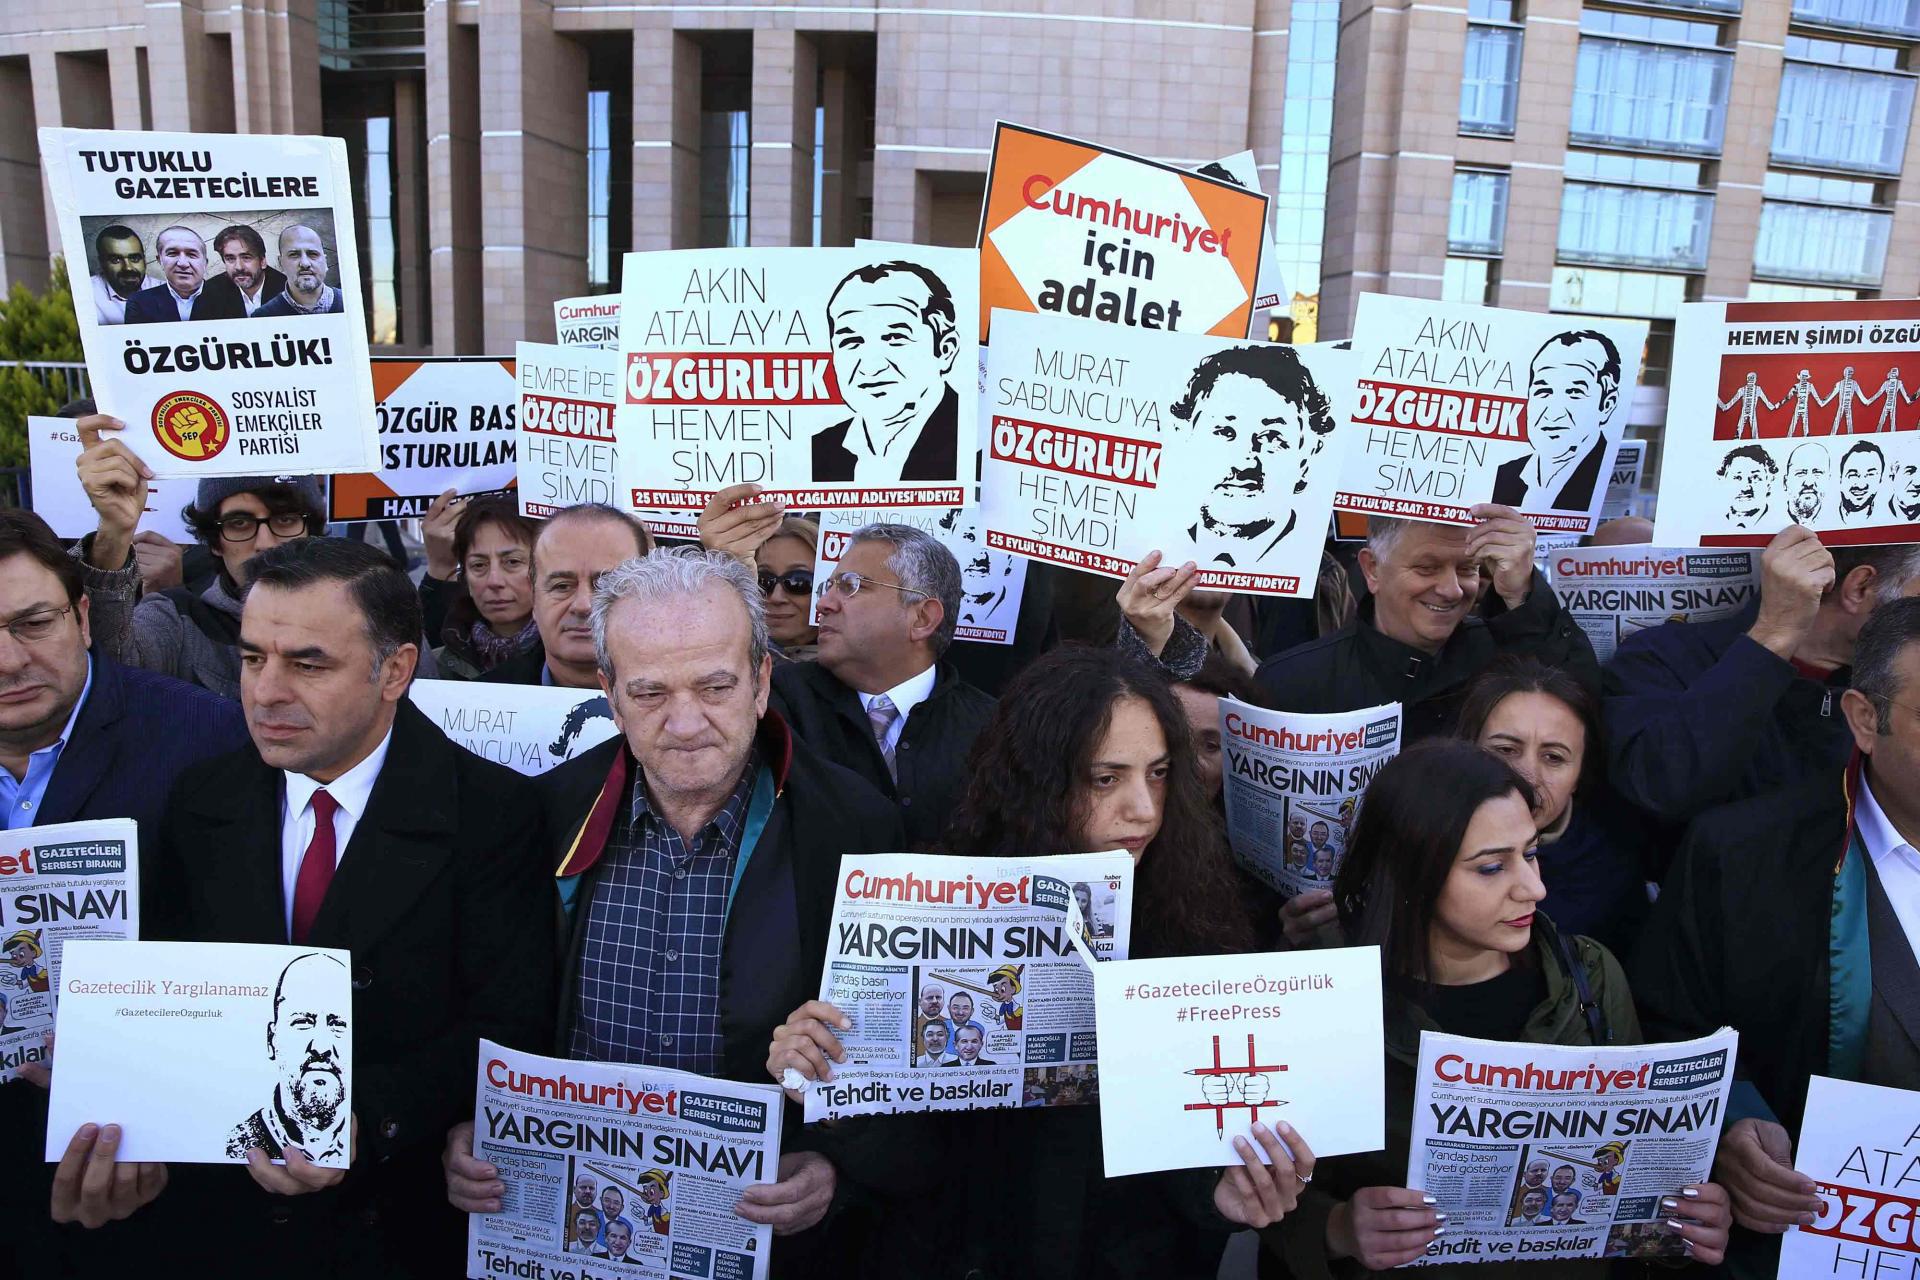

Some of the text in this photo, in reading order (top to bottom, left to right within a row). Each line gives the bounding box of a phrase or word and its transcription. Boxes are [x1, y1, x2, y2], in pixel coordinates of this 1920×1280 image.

[79, 151, 212, 172] TUTUKLU
[115, 172, 319, 199] GAZETECİLERE
[1022, 175, 1233, 257] Cumhuriyet
[1084, 230, 1155, 281] için
[683, 267, 765, 304] AKIN
[1037, 278, 1182, 332] adalet
[644, 310, 811, 345] ATALAY'A
[1415, 316, 1490, 352] AKIN
[1728, 324, 1920, 349] HEMEN ŞİMDİ ÖZGÜ
[123, 334, 332, 374] ÖZGÜRLÜK!
[1035, 348, 1130, 387] MURAT
[1373, 347, 1513, 391] ATALAY'A
[523, 364, 577, 394] EMRE
[627, 355, 832, 400] ÖZGÜRLÜK
[232, 387, 317, 409] SOSYALİST
[998, 378, 1160, 432] SABUNCU'YA
[1352, 383, 1520, 437] ÖZGÜRLÜK
[236, 412, 322, 434] EMEKÇİLER
[376, 401, 457, 434] ÖZGÜR
[523, 397, 616, 439] ÖZGÜRL
[652, 409, 792, 441] HEMEN
[182, 432, 198, 440] SEP
[240, 436, 299, 455] PARTİSİ
[994, 419, 1161, 484] ÖZGÜRLÜK
[1366, 428, 1487, 467] HEMEN
[380, 440, 516, 470] STURULAM
[672, 444, 773, 490] ŞİMDİ
[1019, 471, 1136, 519] HEMEN
[1375, 460, 1465, 499] ŞİMDİ
[528, 504, 537, 514] 25
[636, 492, 650, 504] 25
[1334, 494, 1349, 505] 25
[1396, 501, 1424, 515] SAAT:
[1032, 506, 1117, 550] ŞİMDİ
[990, 533, 1004, 546] 25
[1054, 545, 1084, 564] SAAT:
[1557, 556, 1747, 578] Cumhuriyet GAZETECİLERİ
[1557, 589, 1665, 611] YARGININ
[443, 708, 518, 734] MURAT
[1225, 713, 1364, 755] Cumhuriyet
[1227, 748, 1344, 795] YARGININ
[40, 844, 121, 858] GAZETECİLERİ
[41, 860, 121, 871] SERBEST BIRAKIN
[845, 870, 1029, 909] Cumhuriyet
[15, 889, 127, 924] SINAVI
[839, 922, 993, 959] YARGININ
[68, 979, 269, 998] Gazetecilik Yargılanamaz
[852, 990, 906, 1001] gösteriyor
[862, 976, 889, 986] basın
[1125, 974, 1334, 1000] #GazetecilereÖzgürlük
[1176, 1004, 1281, 1023] #FreePress
[486, 1059, 761, 1117] Cumhuriyet GAZETECİLERİ
[1435, 1054, 1724, 1094] Cumhuriyet GAZETECİLERİ
[1653, 1070, 1720, 1086] SERBEST BIRAKIN
[897, 1086, 924, 1101] ve
[930, 1079, 1013, 1101] baskılar
[684, 1109, 760, 1129] SERBEST BIRAKIN
[1430, 1097, 1720, 1139] YARGININ SINAVI
[484, 1106, 763, 1180] YARGININ SINAVI
[1429, 1149, 1497, 1163] Yandaş basın
[485, 1152, 520, 1167] Yandaş
[522, 1158, 546, 1170] basın
[1428, 1162, 1513, 1175] niyeti gösteriyor
[513, 1169, 562, 1185] gösteriyor
[1425, 1236, 1598, 1257] ehdit ve baskılar
[1833, 1243, 1920, 1280] HE
